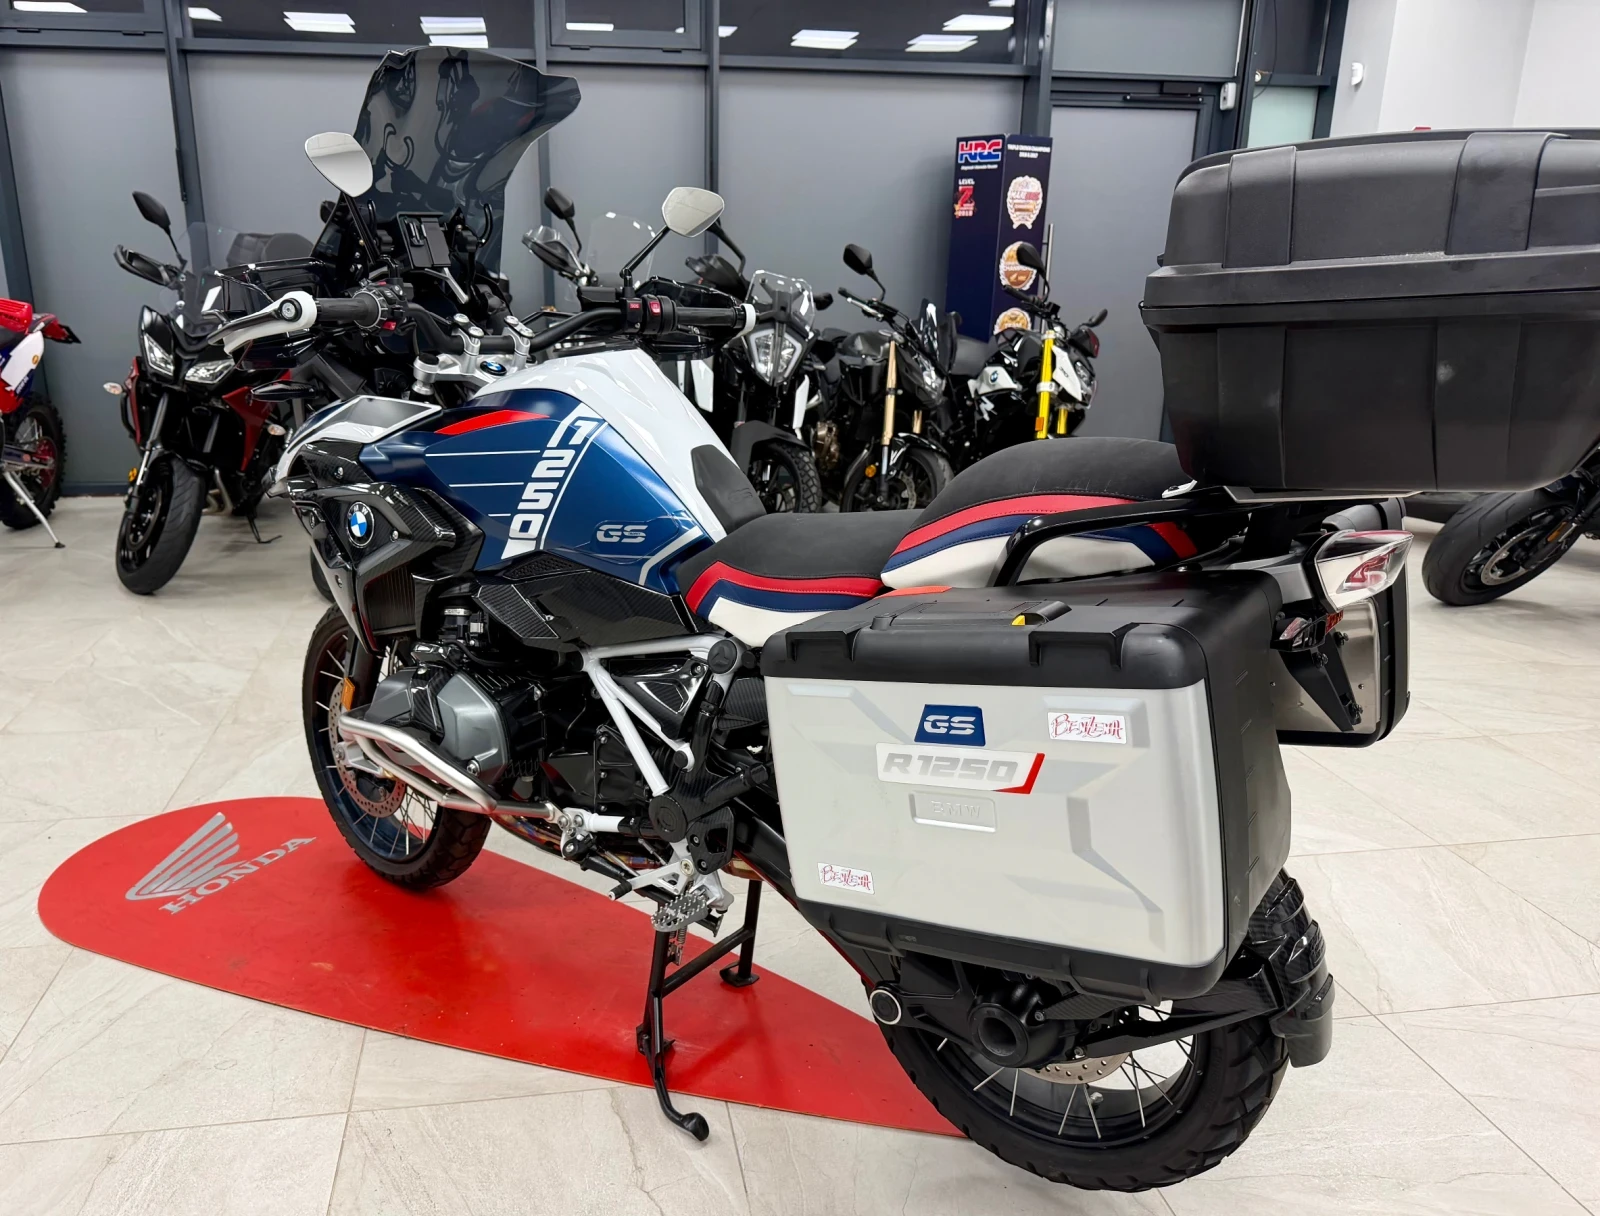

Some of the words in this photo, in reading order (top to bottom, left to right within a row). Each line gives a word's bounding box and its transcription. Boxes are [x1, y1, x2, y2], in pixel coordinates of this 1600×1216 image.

[958, 139, 1002, 163] HRC
[509, 420, 599, 539] 1250
[597, 525, 648, 543] GS
[924, 714, 976, 735] GS
[931, 800, 981, 818] BMW
[159, 836, 317, 915] HONDA
